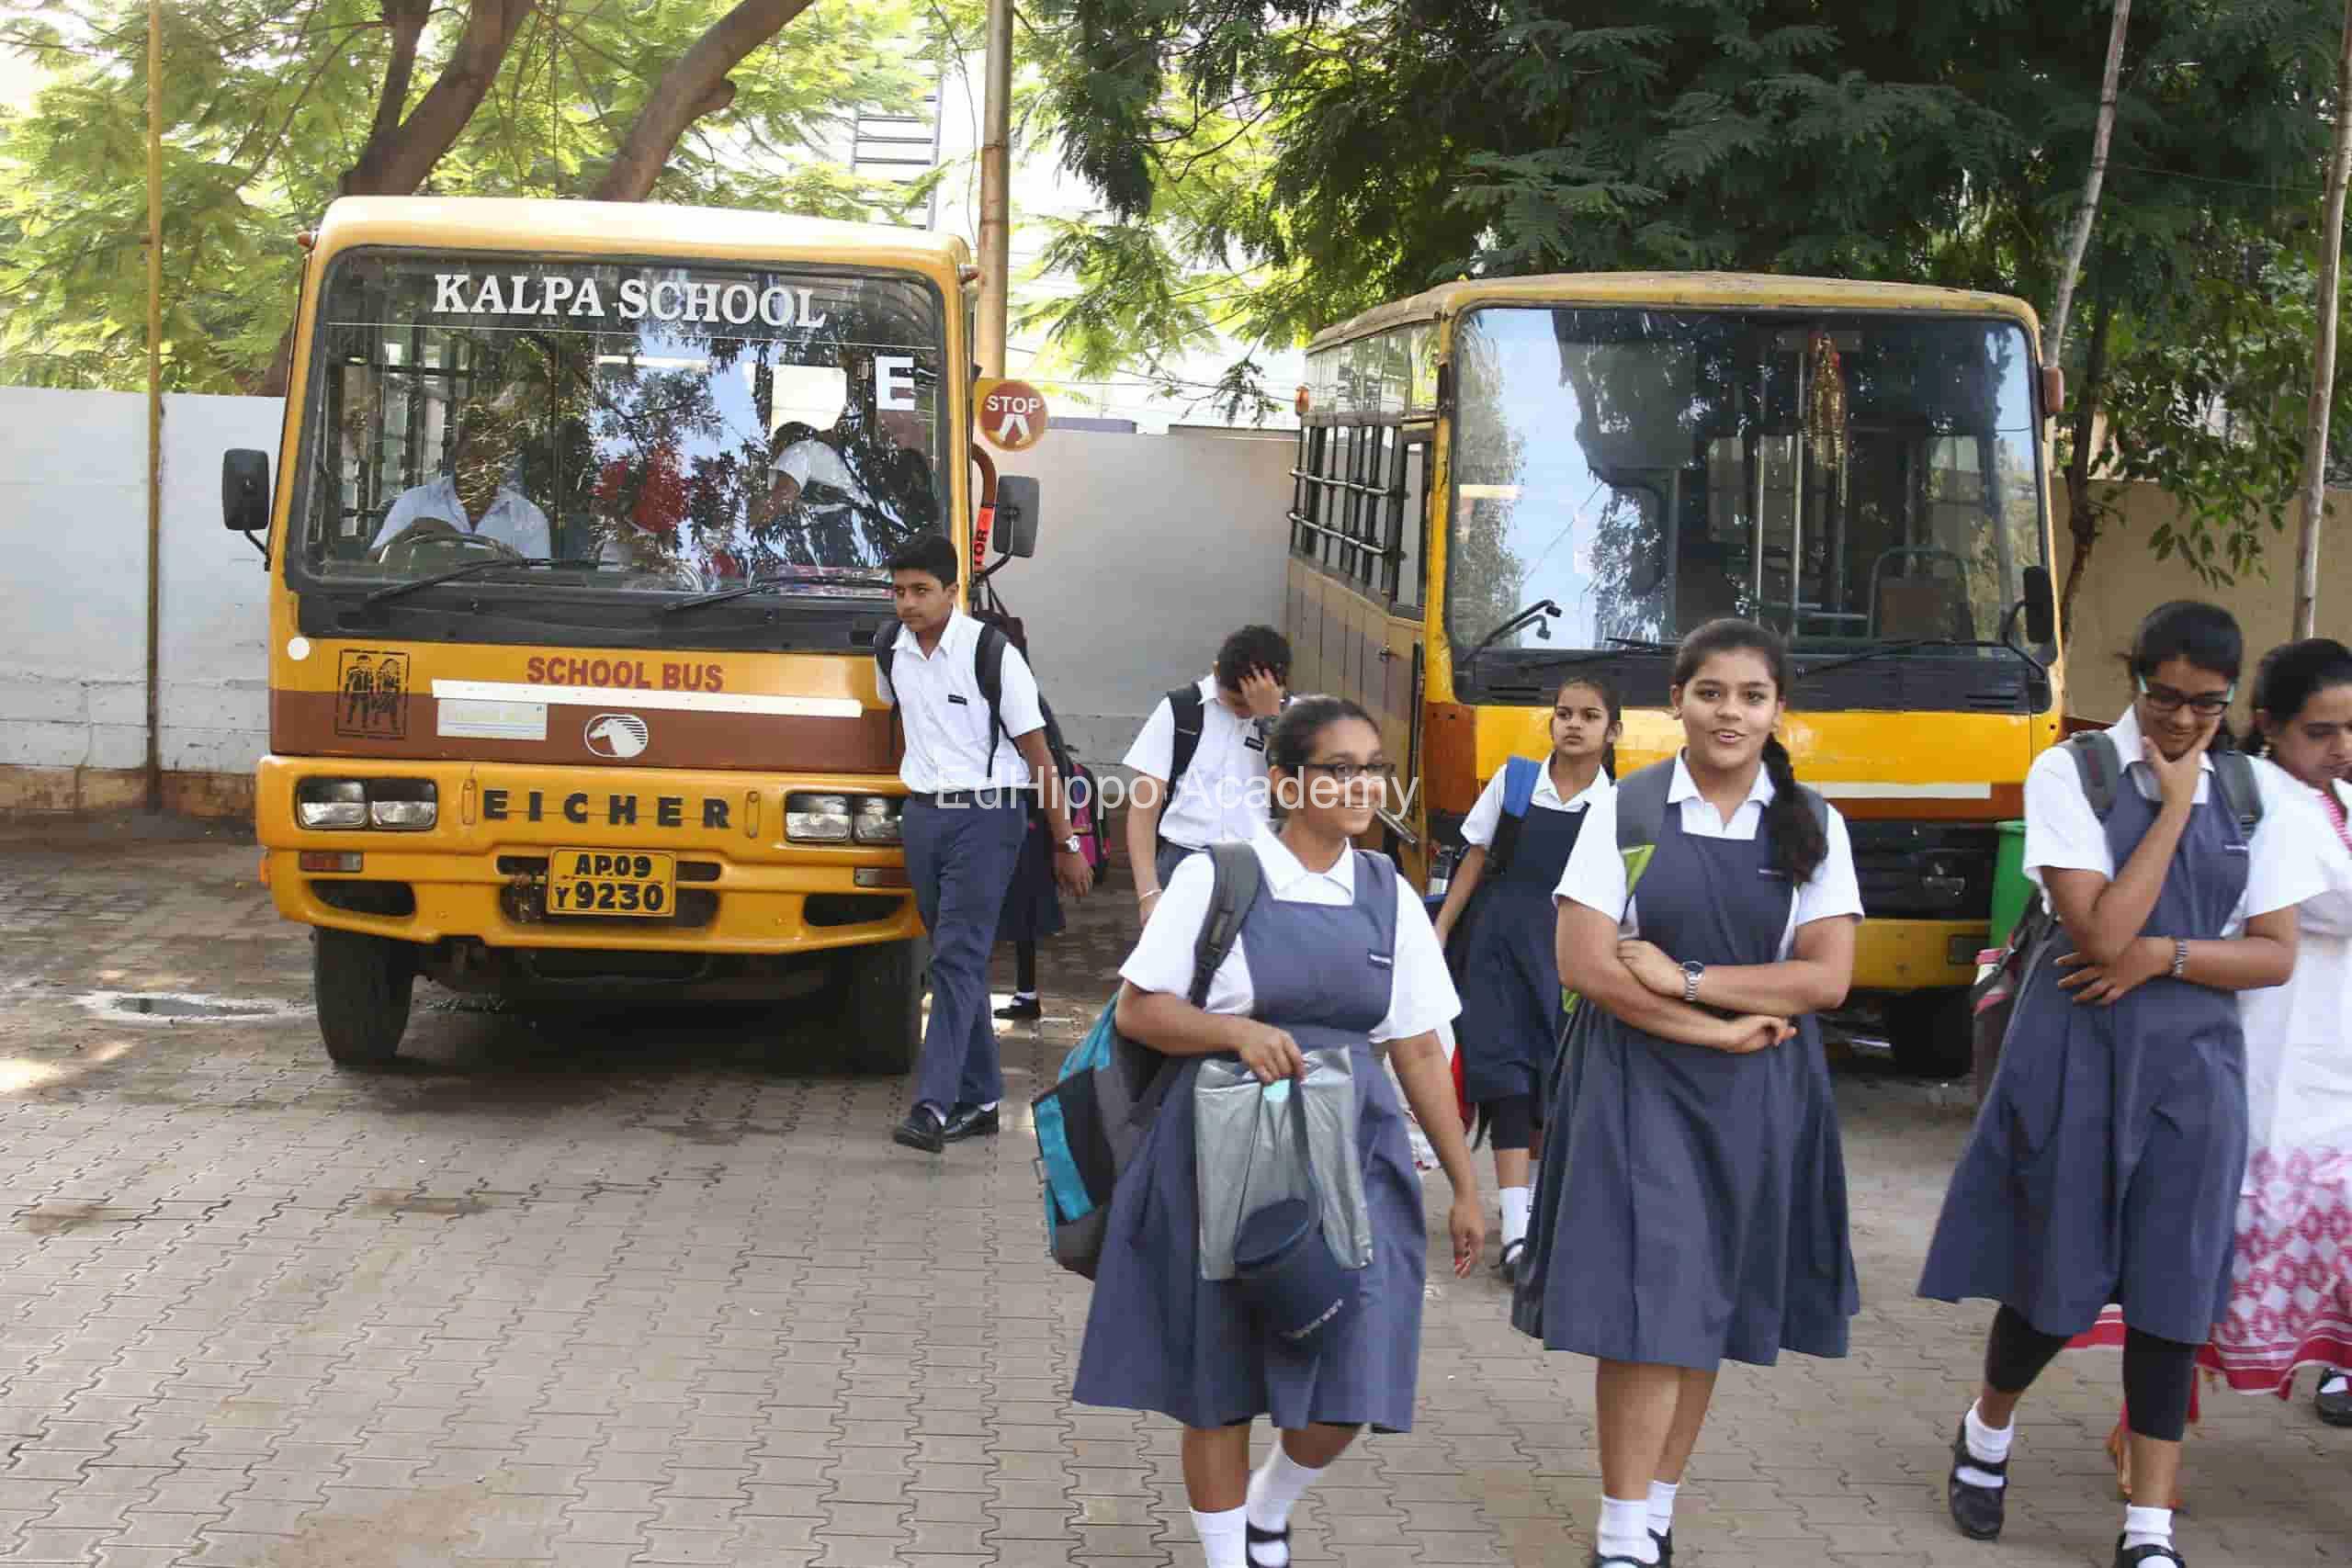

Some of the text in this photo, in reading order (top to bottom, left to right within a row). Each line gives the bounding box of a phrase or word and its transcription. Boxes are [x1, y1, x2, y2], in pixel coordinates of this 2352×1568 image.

[433, 274, 826, 328] KALPA SCHOOL
[875, 355, 915, 412] E
[987, 396, 1041, 413] STOP
[526, 656, 723, 693] SCHOOL BUS
[483, 790, 730, 829] EICHER
[555, 881, 663, 911] Y 9230
